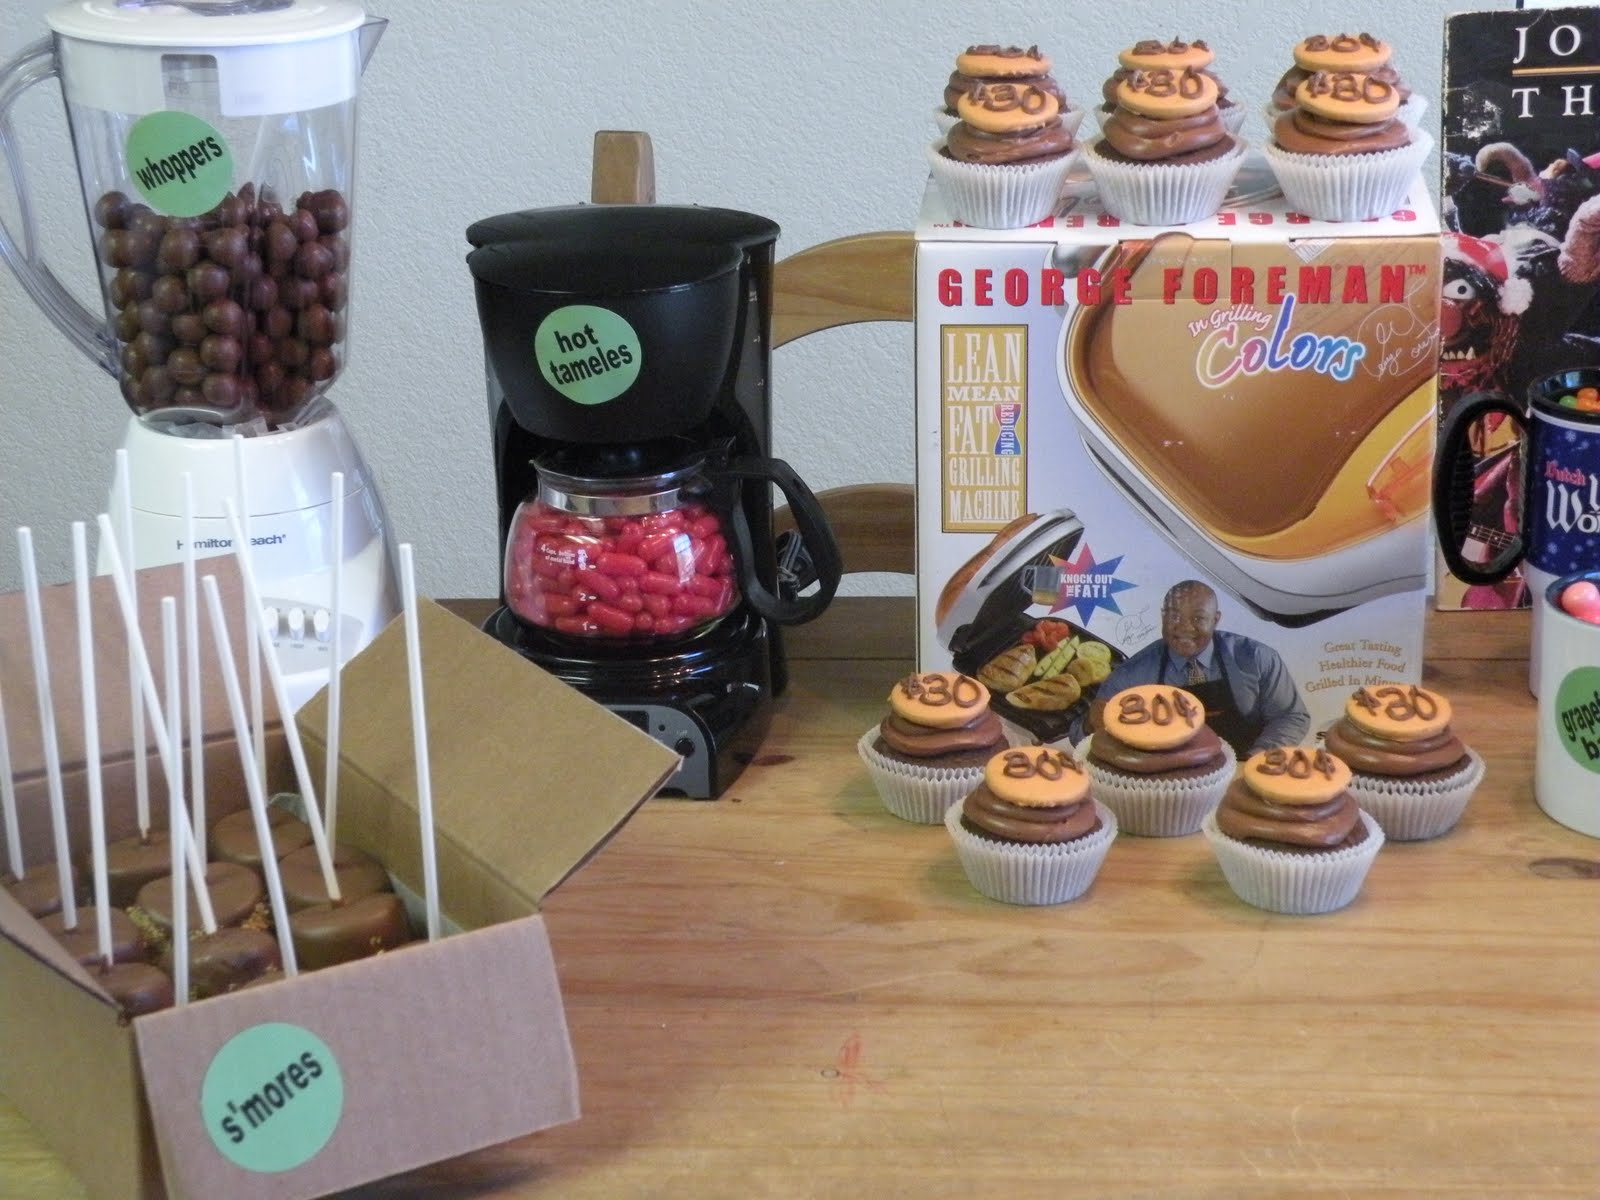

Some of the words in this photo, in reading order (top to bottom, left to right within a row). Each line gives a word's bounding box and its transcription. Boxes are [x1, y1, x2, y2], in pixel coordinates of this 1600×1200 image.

[136, 136, 223, 191] whoppers
[938, 268, 1133, 307] GEORGE
[1188, 319, 1209, 338] In
[1210, 303, 1273, 331] Grilling
[553, 323, 599, 353] hot
[1196, 293, 1366, 388] Colors
[549, 344, 633, 385] tameles
[946, 332, 1024, 383] LEAN
[946, 386, 1022, 402] MEAN
[947, 405, 994, 454] FAT
[1000, 404, 1015, 455] REDUCING
[949, 457, 1020, 486] GRILLING
[949, 490, 1020, 523] MACHINE
[1060, 573, 1093, 585] KNOCK
[1094, 574, 1113, 585] OUT
[1074, 585, 1107, 598] FAT!
[580, 592, 586, 602] 2
[1324, 641, 1356, 653] Great
[1359, 639, 1402, 656] Tasting
[1318, 658, 1373, 672] Healthier
[1376, 658, 1406, 673] Food
[1305, 676, 1346, 693] Grilled
[1348, 675, 1361, 686] In
[221, 1051, 323, 1143] s'mores
